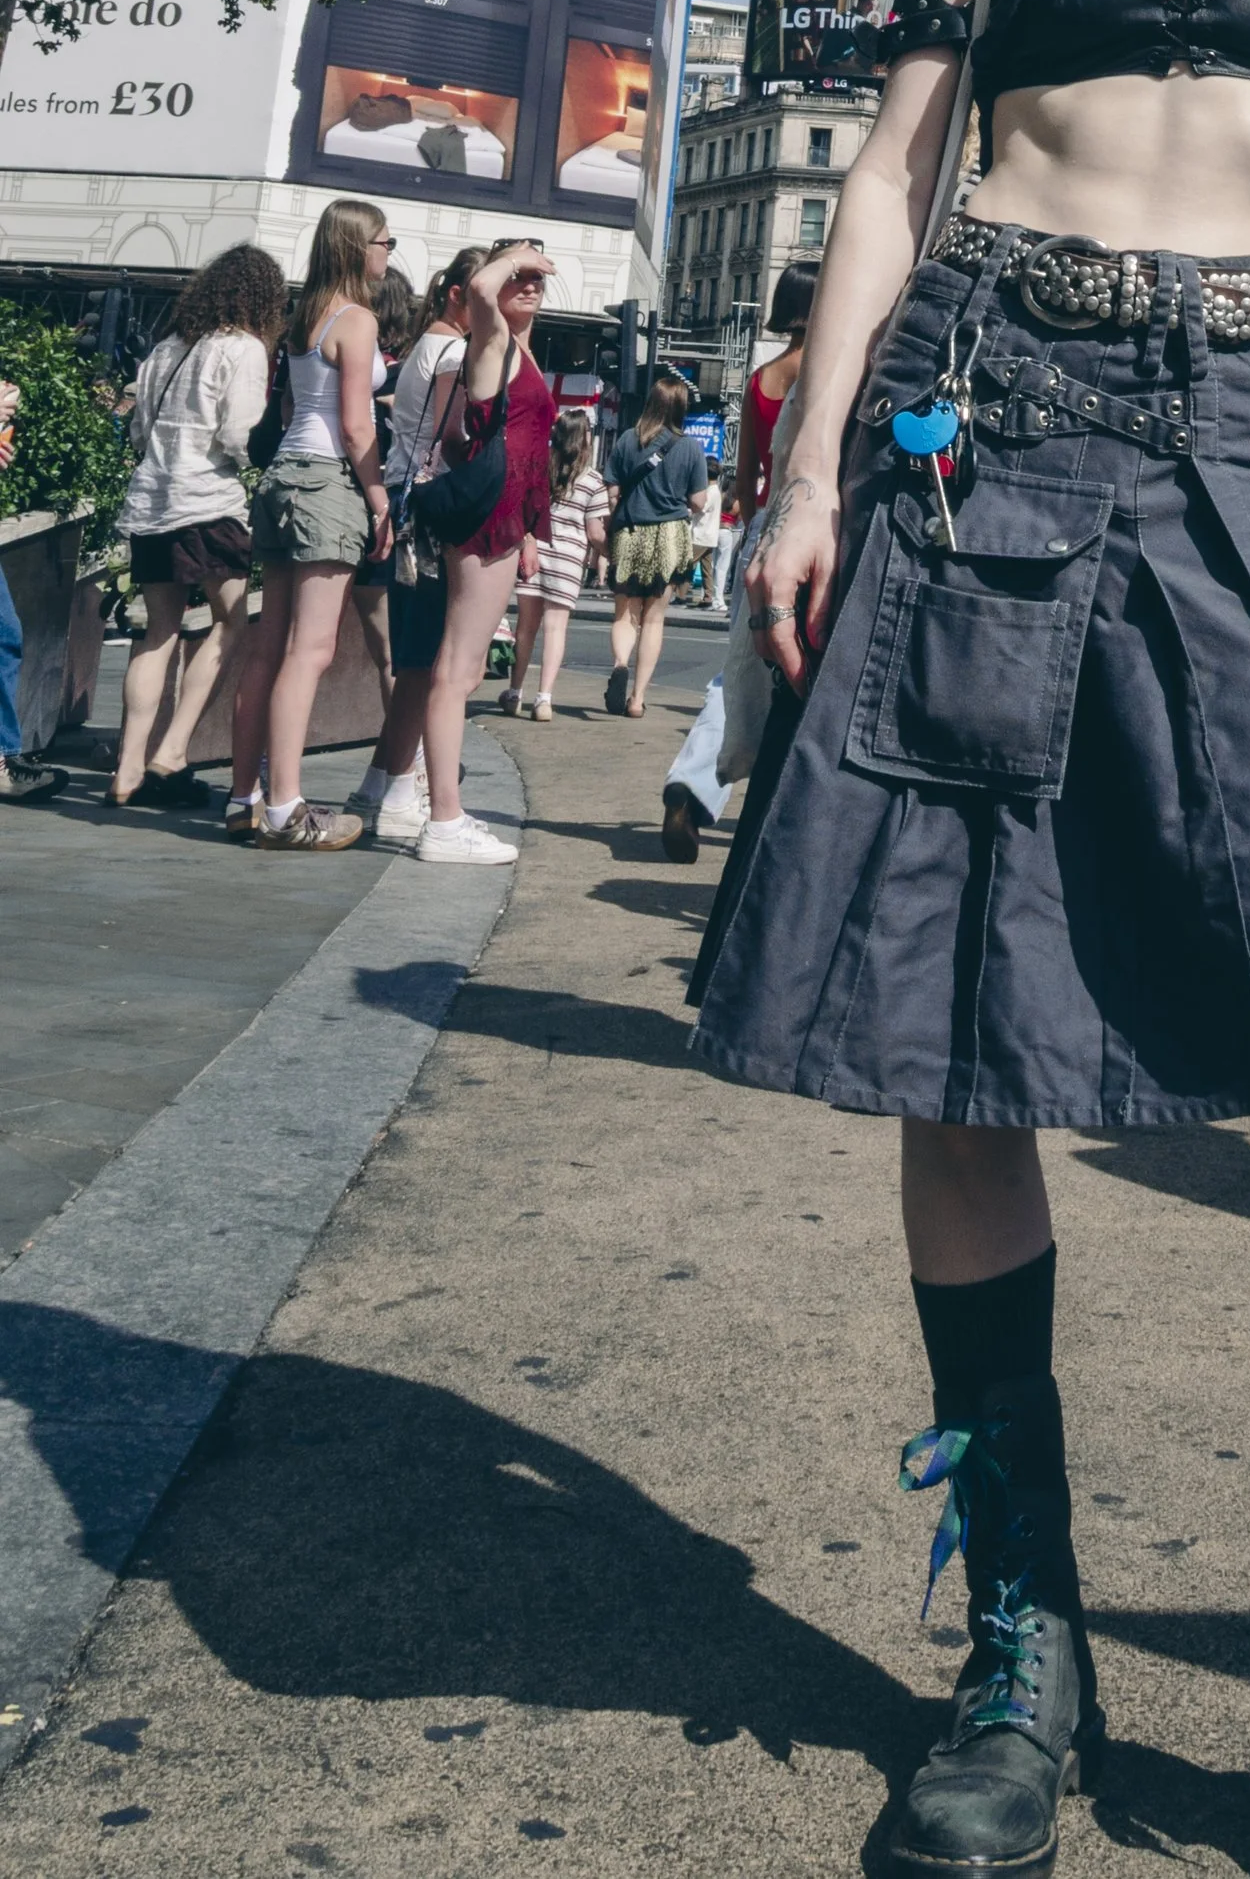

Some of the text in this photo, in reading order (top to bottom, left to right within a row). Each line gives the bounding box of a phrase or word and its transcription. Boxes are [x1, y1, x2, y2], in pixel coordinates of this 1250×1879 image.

[780, 7, 812, 29] LG
[834, 78, 848, 88] LG
[46, 92, 99, 115] from
[109, 80, 194, 117] £30
